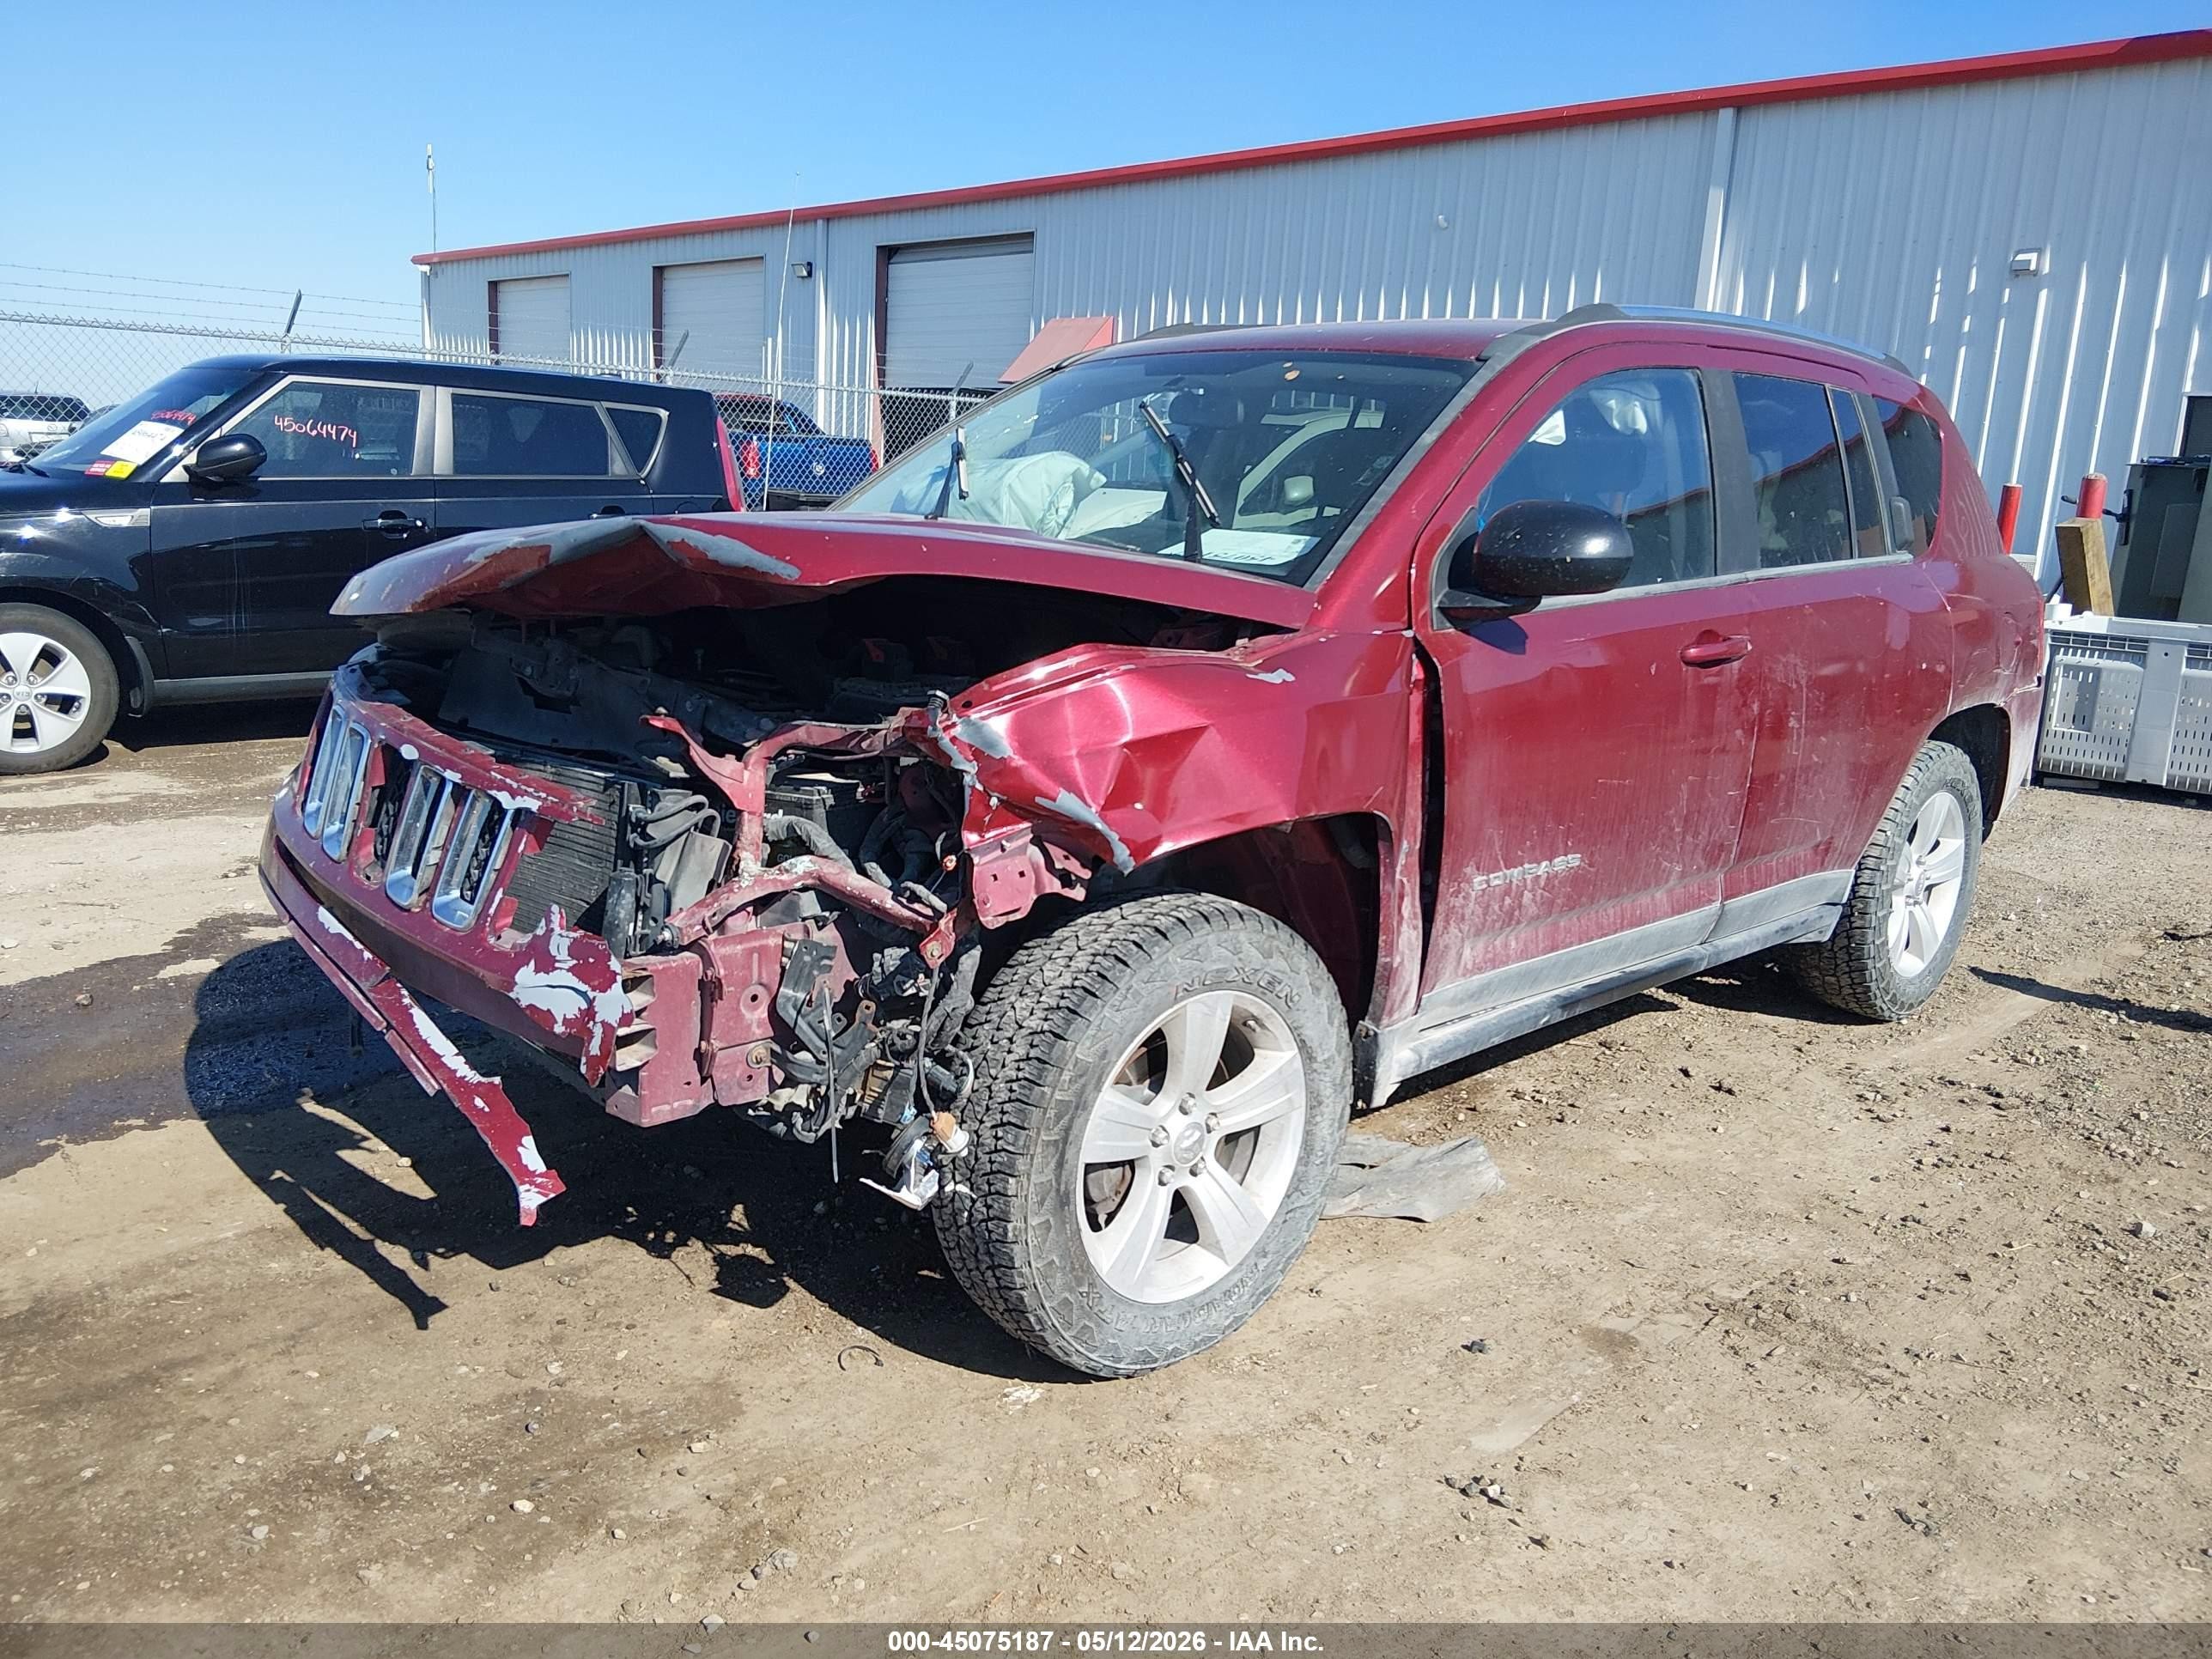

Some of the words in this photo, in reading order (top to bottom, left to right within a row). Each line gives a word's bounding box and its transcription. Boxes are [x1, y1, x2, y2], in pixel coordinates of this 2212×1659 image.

[274, 415, 357, 448] 45064474
[1472, 854, 1583, 892] COMPASS
[1174, 966, 1302, 1010] NEXEN
